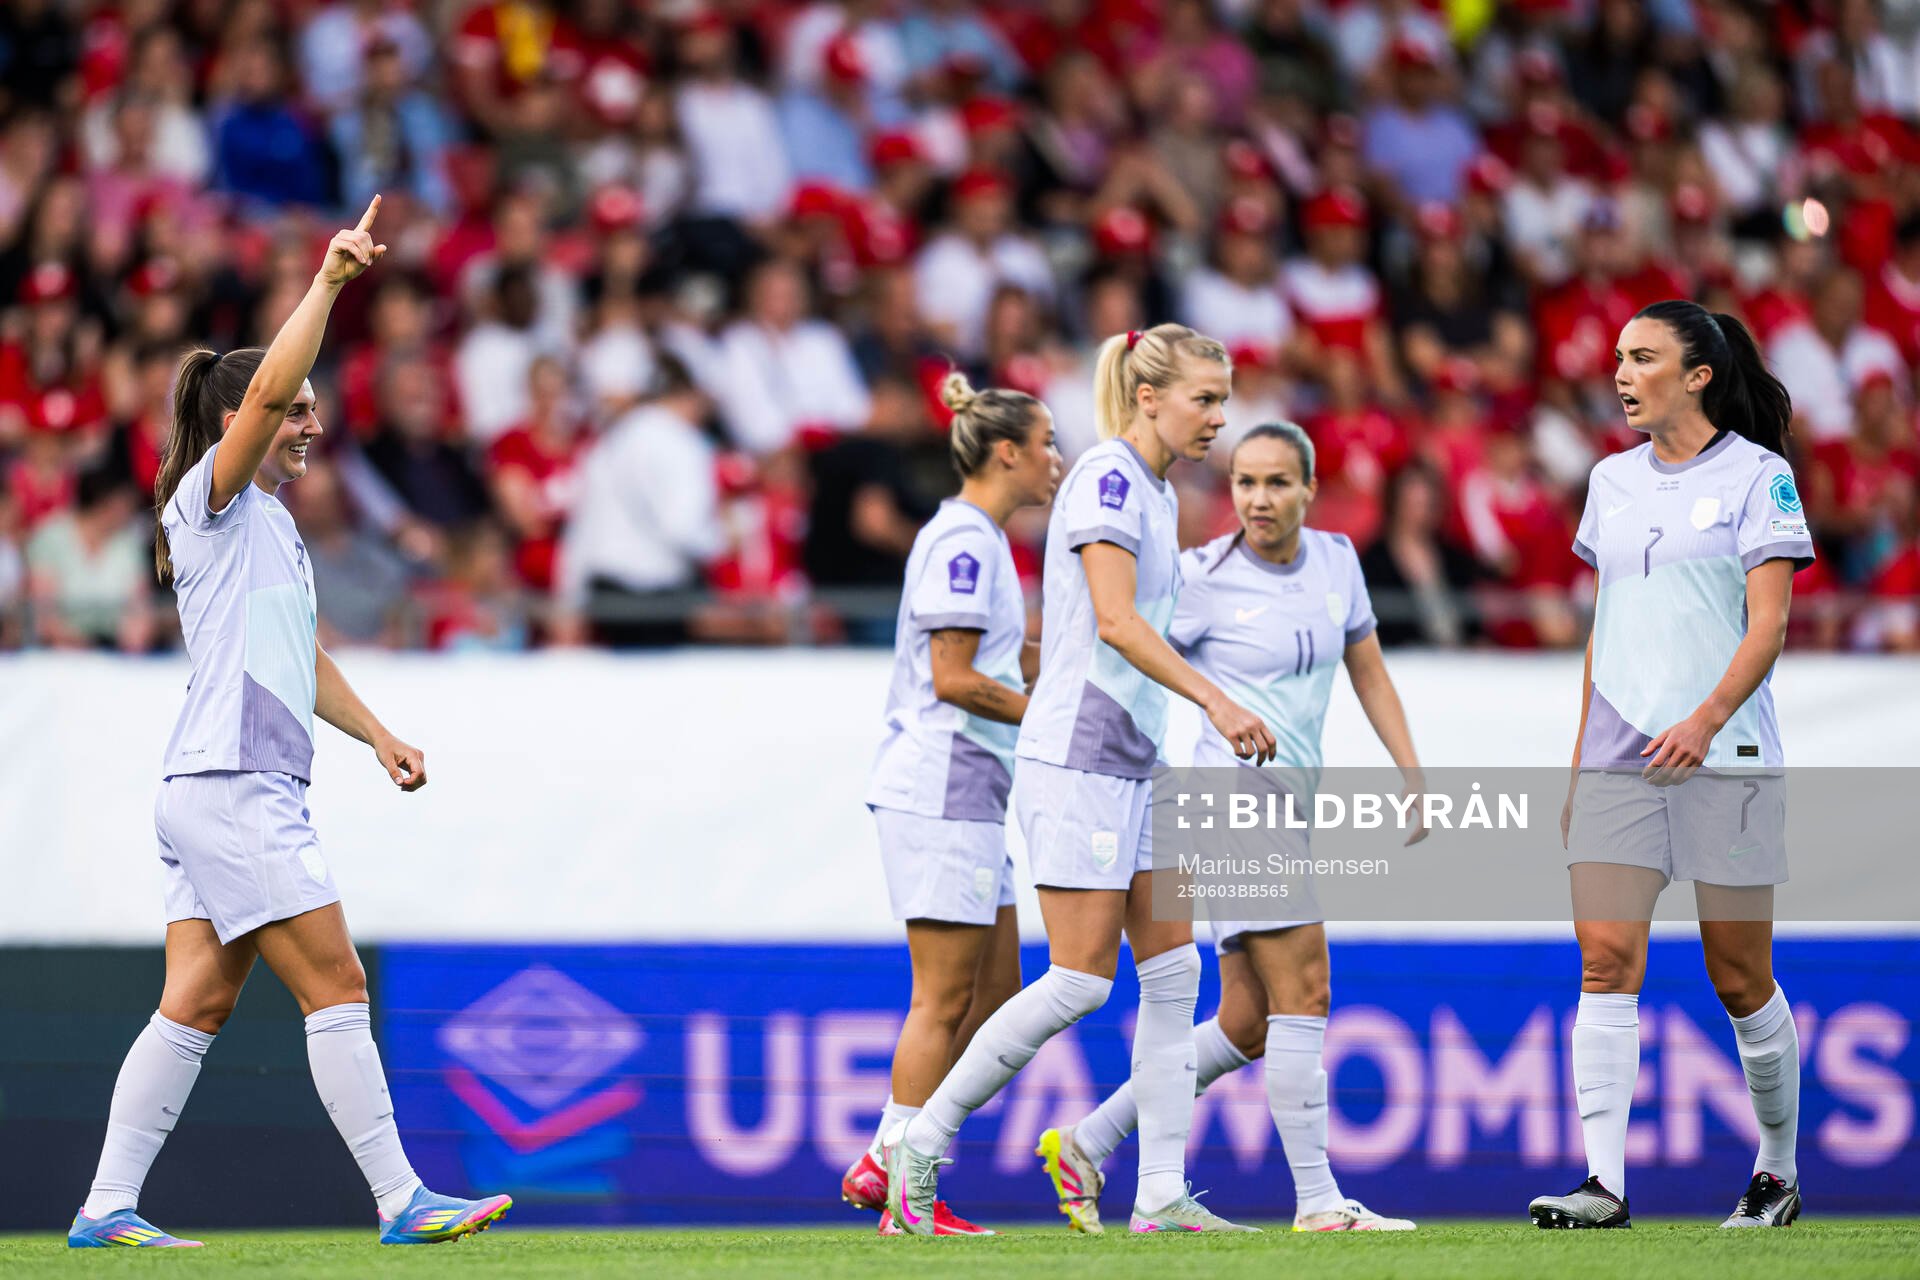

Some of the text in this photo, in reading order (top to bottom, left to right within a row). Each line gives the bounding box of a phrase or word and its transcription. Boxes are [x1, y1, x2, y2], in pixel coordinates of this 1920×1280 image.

[1644, 526, 1664, 578] 7
[1295, 630, 1314, 676] 11
[1740, 780, 1760, 834] 7
